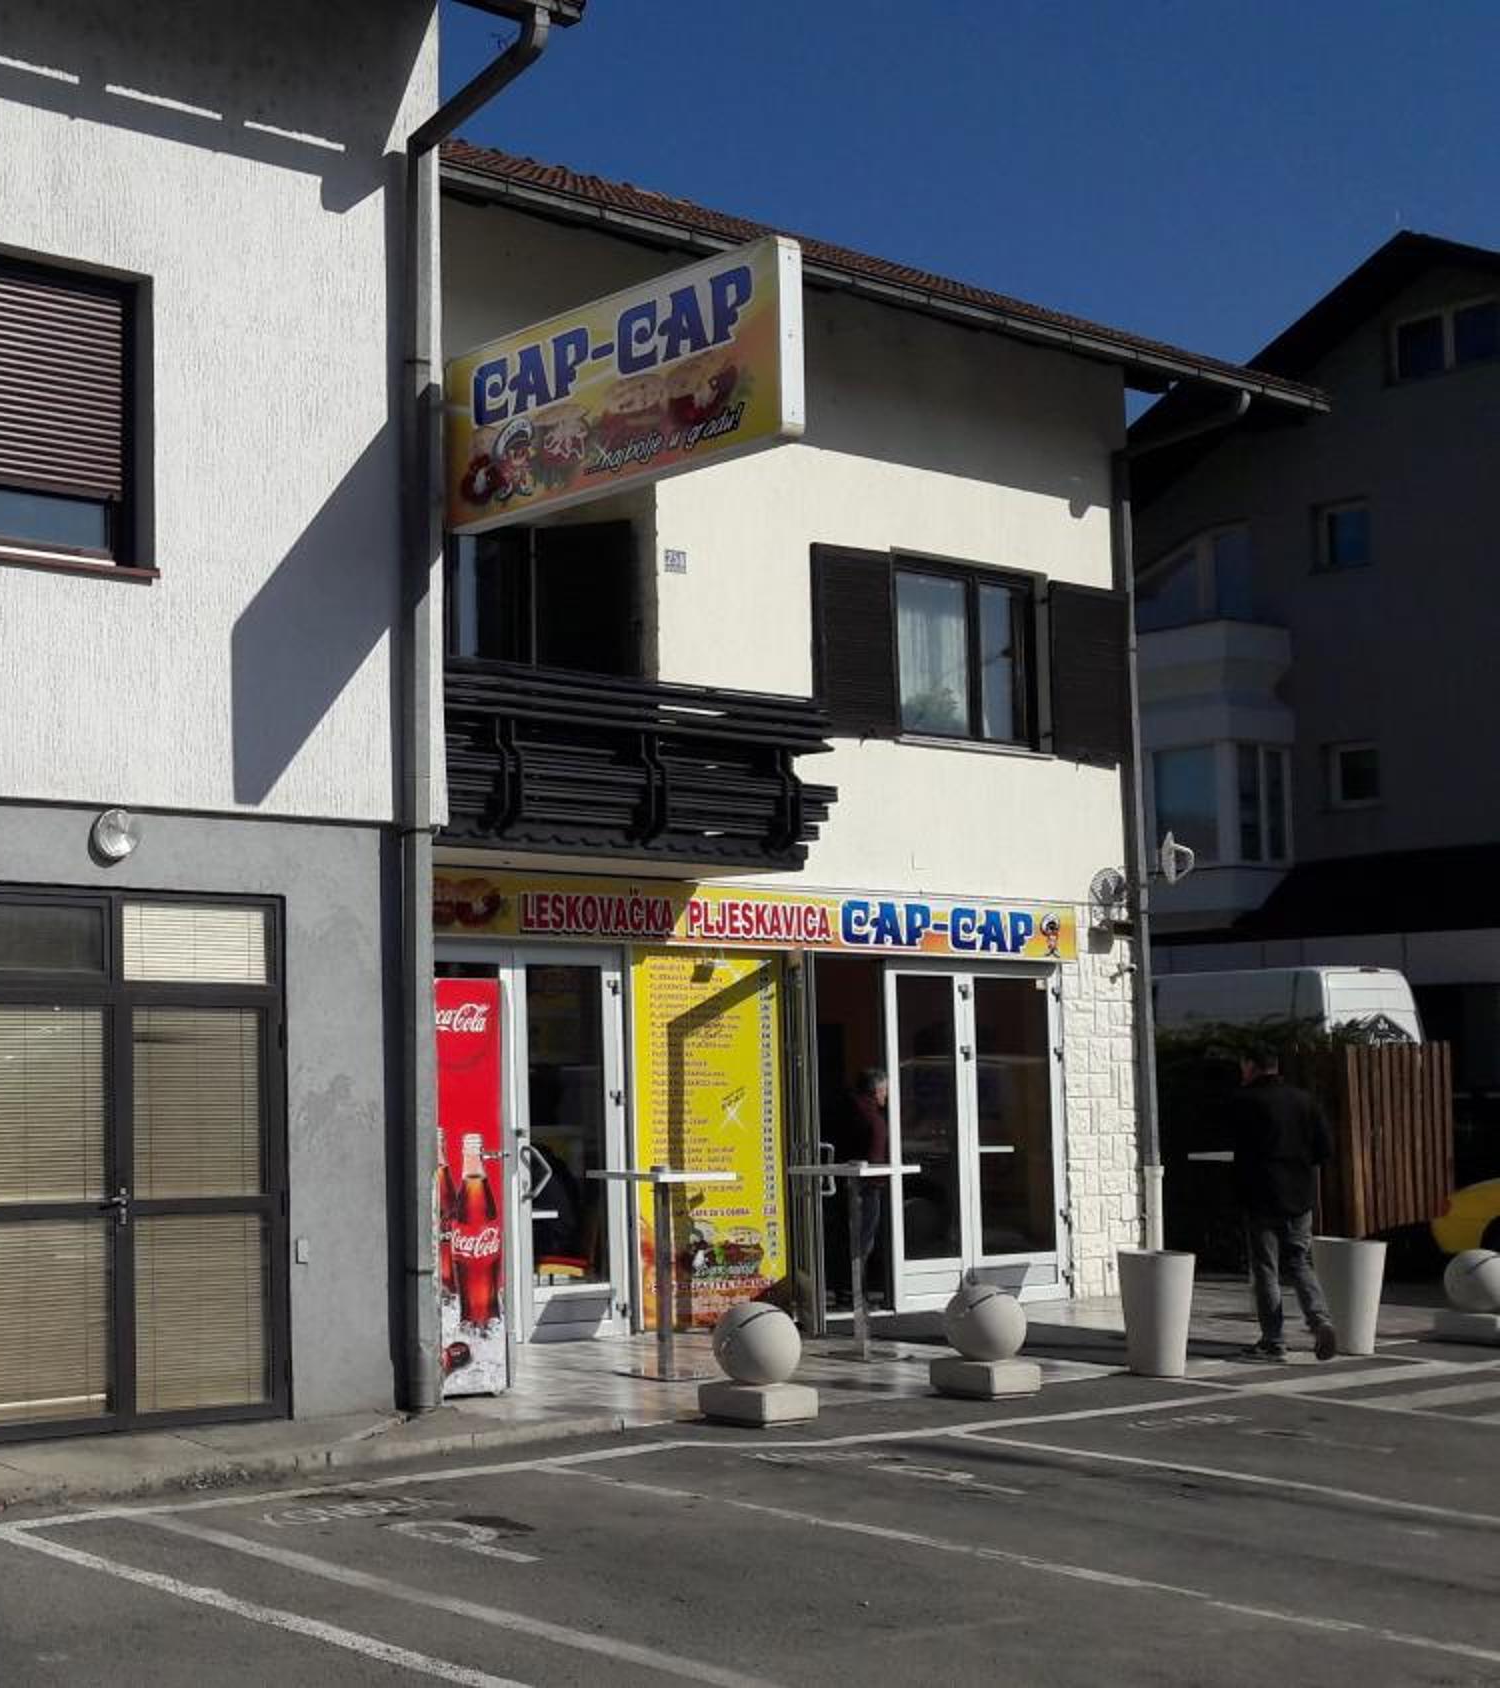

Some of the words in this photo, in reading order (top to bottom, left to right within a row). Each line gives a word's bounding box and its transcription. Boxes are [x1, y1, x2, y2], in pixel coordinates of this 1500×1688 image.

[472, 265, 754, 427] CAP-CAP
[521, 888, 678, 935] LESKOVAČKA
[688, 900, 833, 943] PLJESKAVICA
[841, 898, 1036, 954] CAP-CAP
